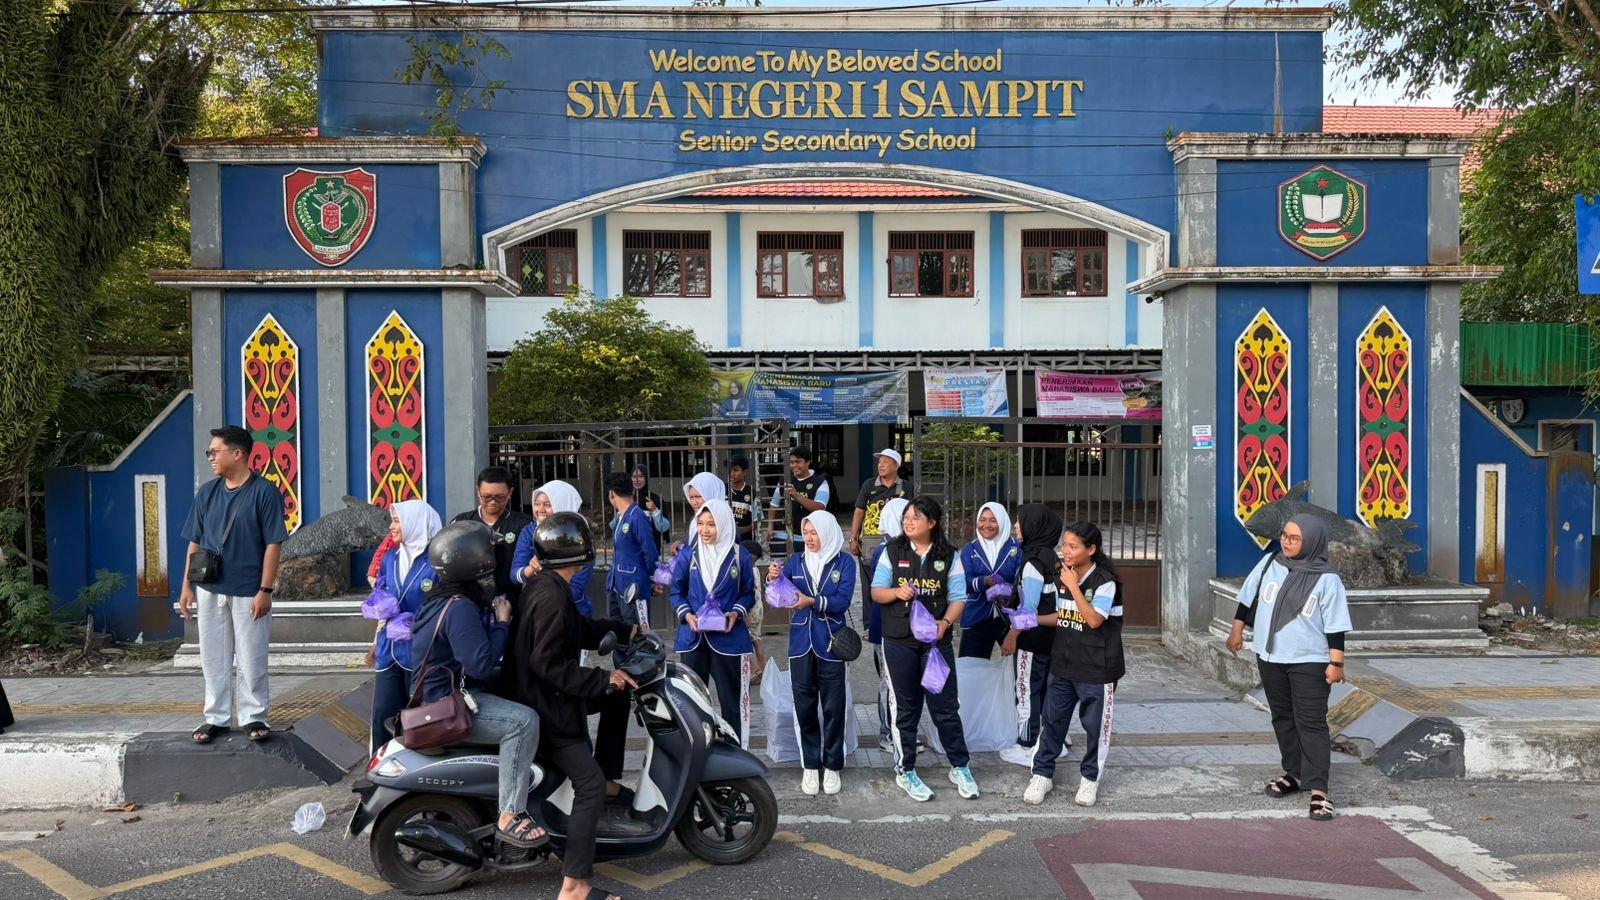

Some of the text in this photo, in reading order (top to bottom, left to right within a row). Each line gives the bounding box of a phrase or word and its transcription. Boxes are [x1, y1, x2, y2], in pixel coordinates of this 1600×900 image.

[649, 49, 1002, 78] Welcome To My Beloved School
[566, 79, 1084, 119] SMA NEGERI 1 SAMPIT
[678, 127, 976, 158] Senior Secondary School
[763, 372, 820, 380] PENERIMAAN
[753, 378, 806, 387] MAHASISWA
[1040, 377, 1093, 386] PENERIMAAN
[1040, 385, 1090, 393] MAHASISWA
[917, 588, 937, 596] PIT
[1057, 608, 1086, 624] MANS
[417, 777, 465, 787] SCOOPY
